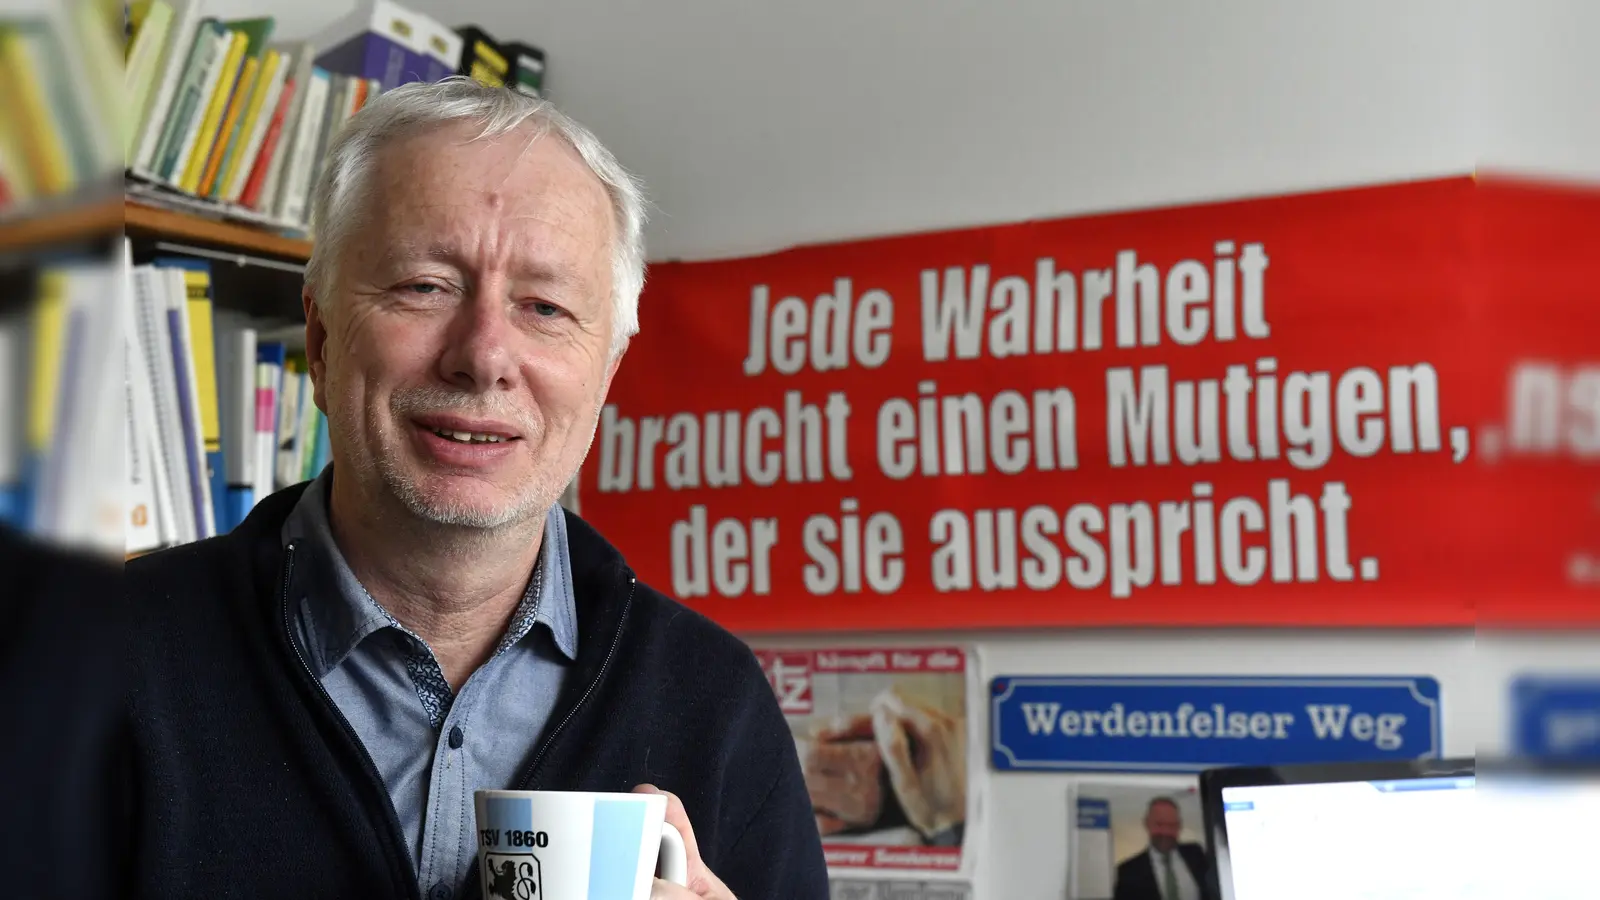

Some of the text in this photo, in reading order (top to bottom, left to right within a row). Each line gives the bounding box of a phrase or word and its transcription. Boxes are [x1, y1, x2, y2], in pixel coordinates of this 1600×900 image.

[743, 240, 1271, 376] Jede Wahrheit
[598, 390, 853, 493] braucht
[876, 380, 1079, 481] einen
[1106, 356, 1470, 471] Mutigen,
[670, 479, 1380, 599] der sie ausspricht.
[1021, 703, 1406, 749] Werdenfelser Weg
[480, 829, 549, 848] TSV 1860
